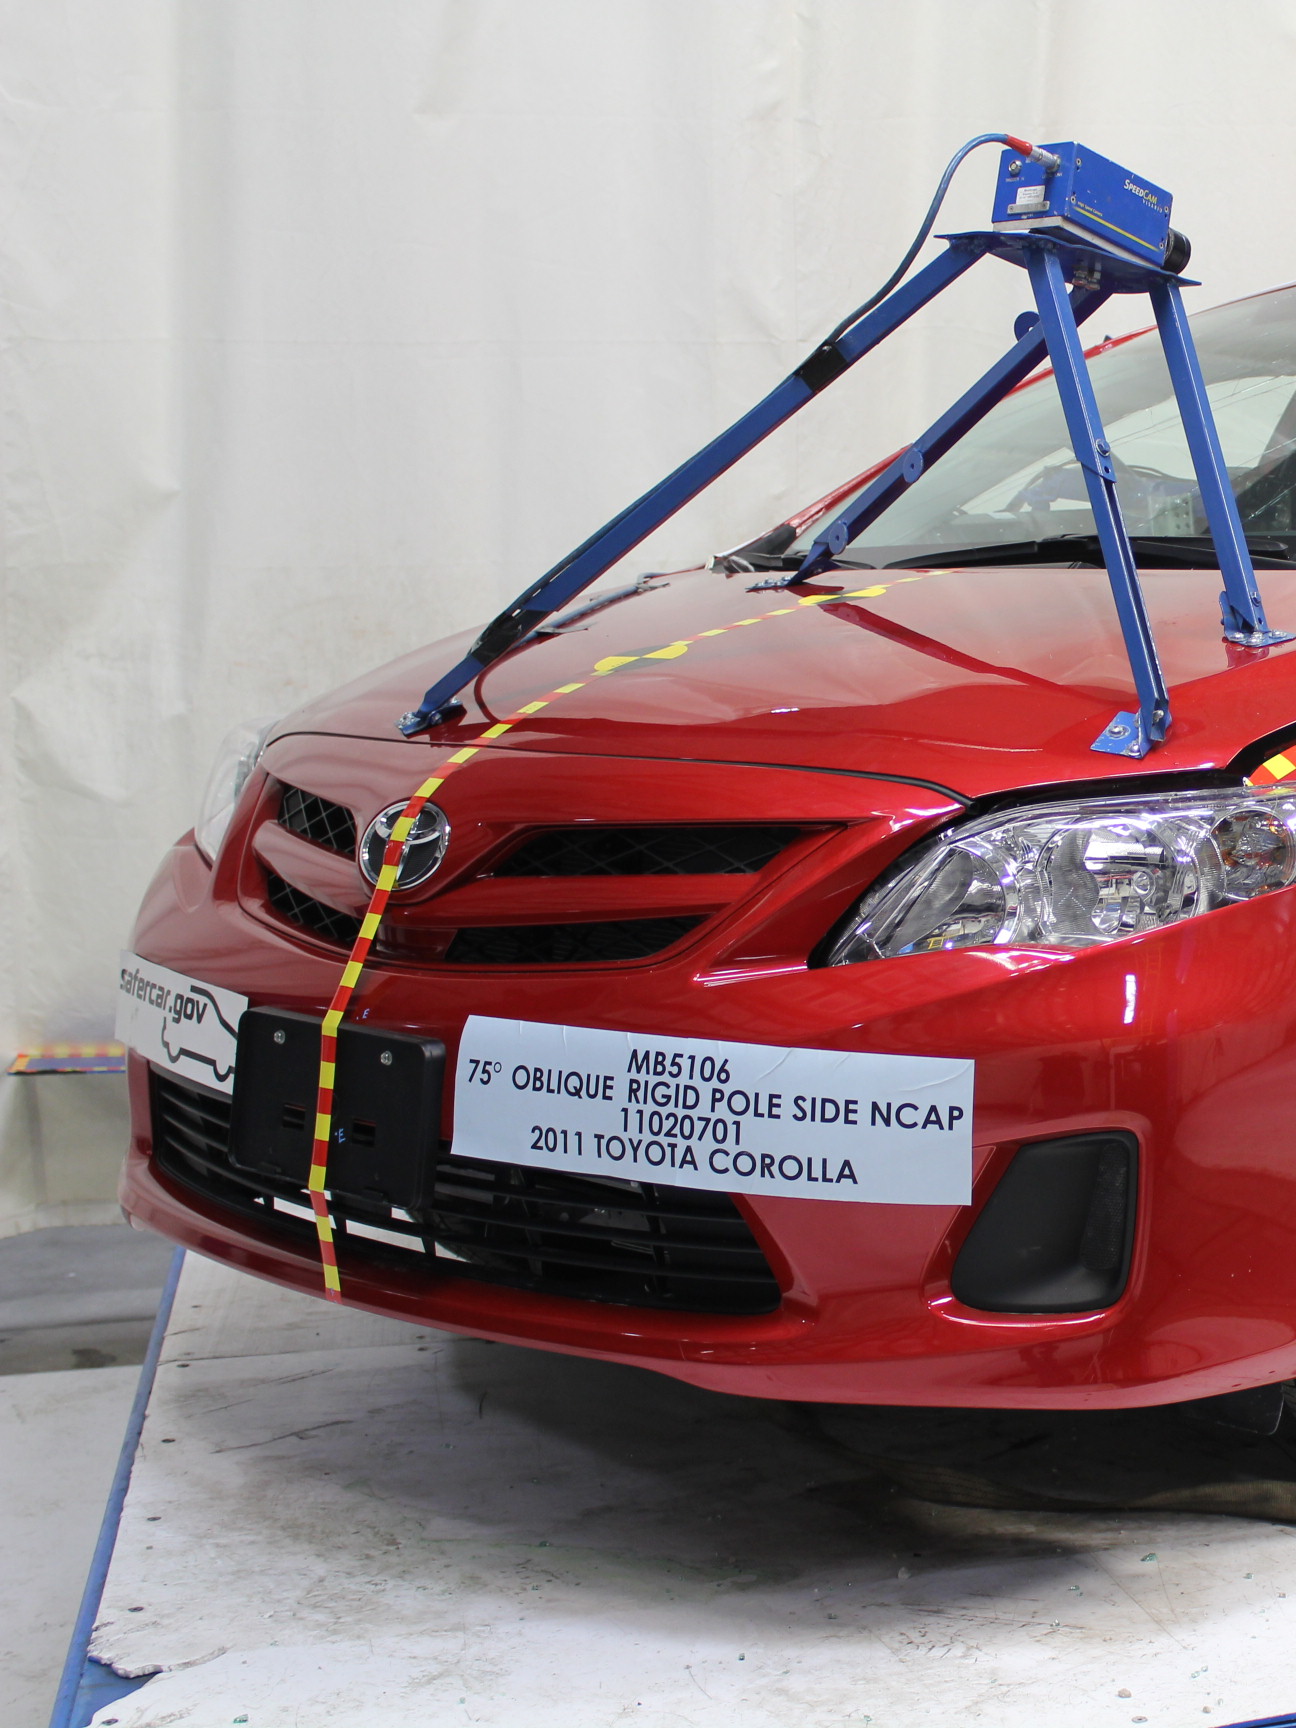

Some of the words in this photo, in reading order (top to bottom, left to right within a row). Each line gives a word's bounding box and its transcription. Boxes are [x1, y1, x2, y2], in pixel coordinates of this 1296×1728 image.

[119, 967, 208, 1025] safercar.gov
[467, 1058, 503, 1086] 75°
[511, 1064, 615, 1101] OBLIQUE
[627, 1078, 701, 1112] RIGID
[710, 1089, 782, 1120] POLE
[792, 1096, 859, 1126] SIDE
[870, 1101, 965, 1132] NCAP
[627, 1048, 731, 1085] MB5106
[530, 1126, 585, 1155] 2011
[593, 1133, 699, 1172] TOYOTA
[708, 1149, 859, 1185] COROLLA
[620, 1107, 742, 1147] 11020701
